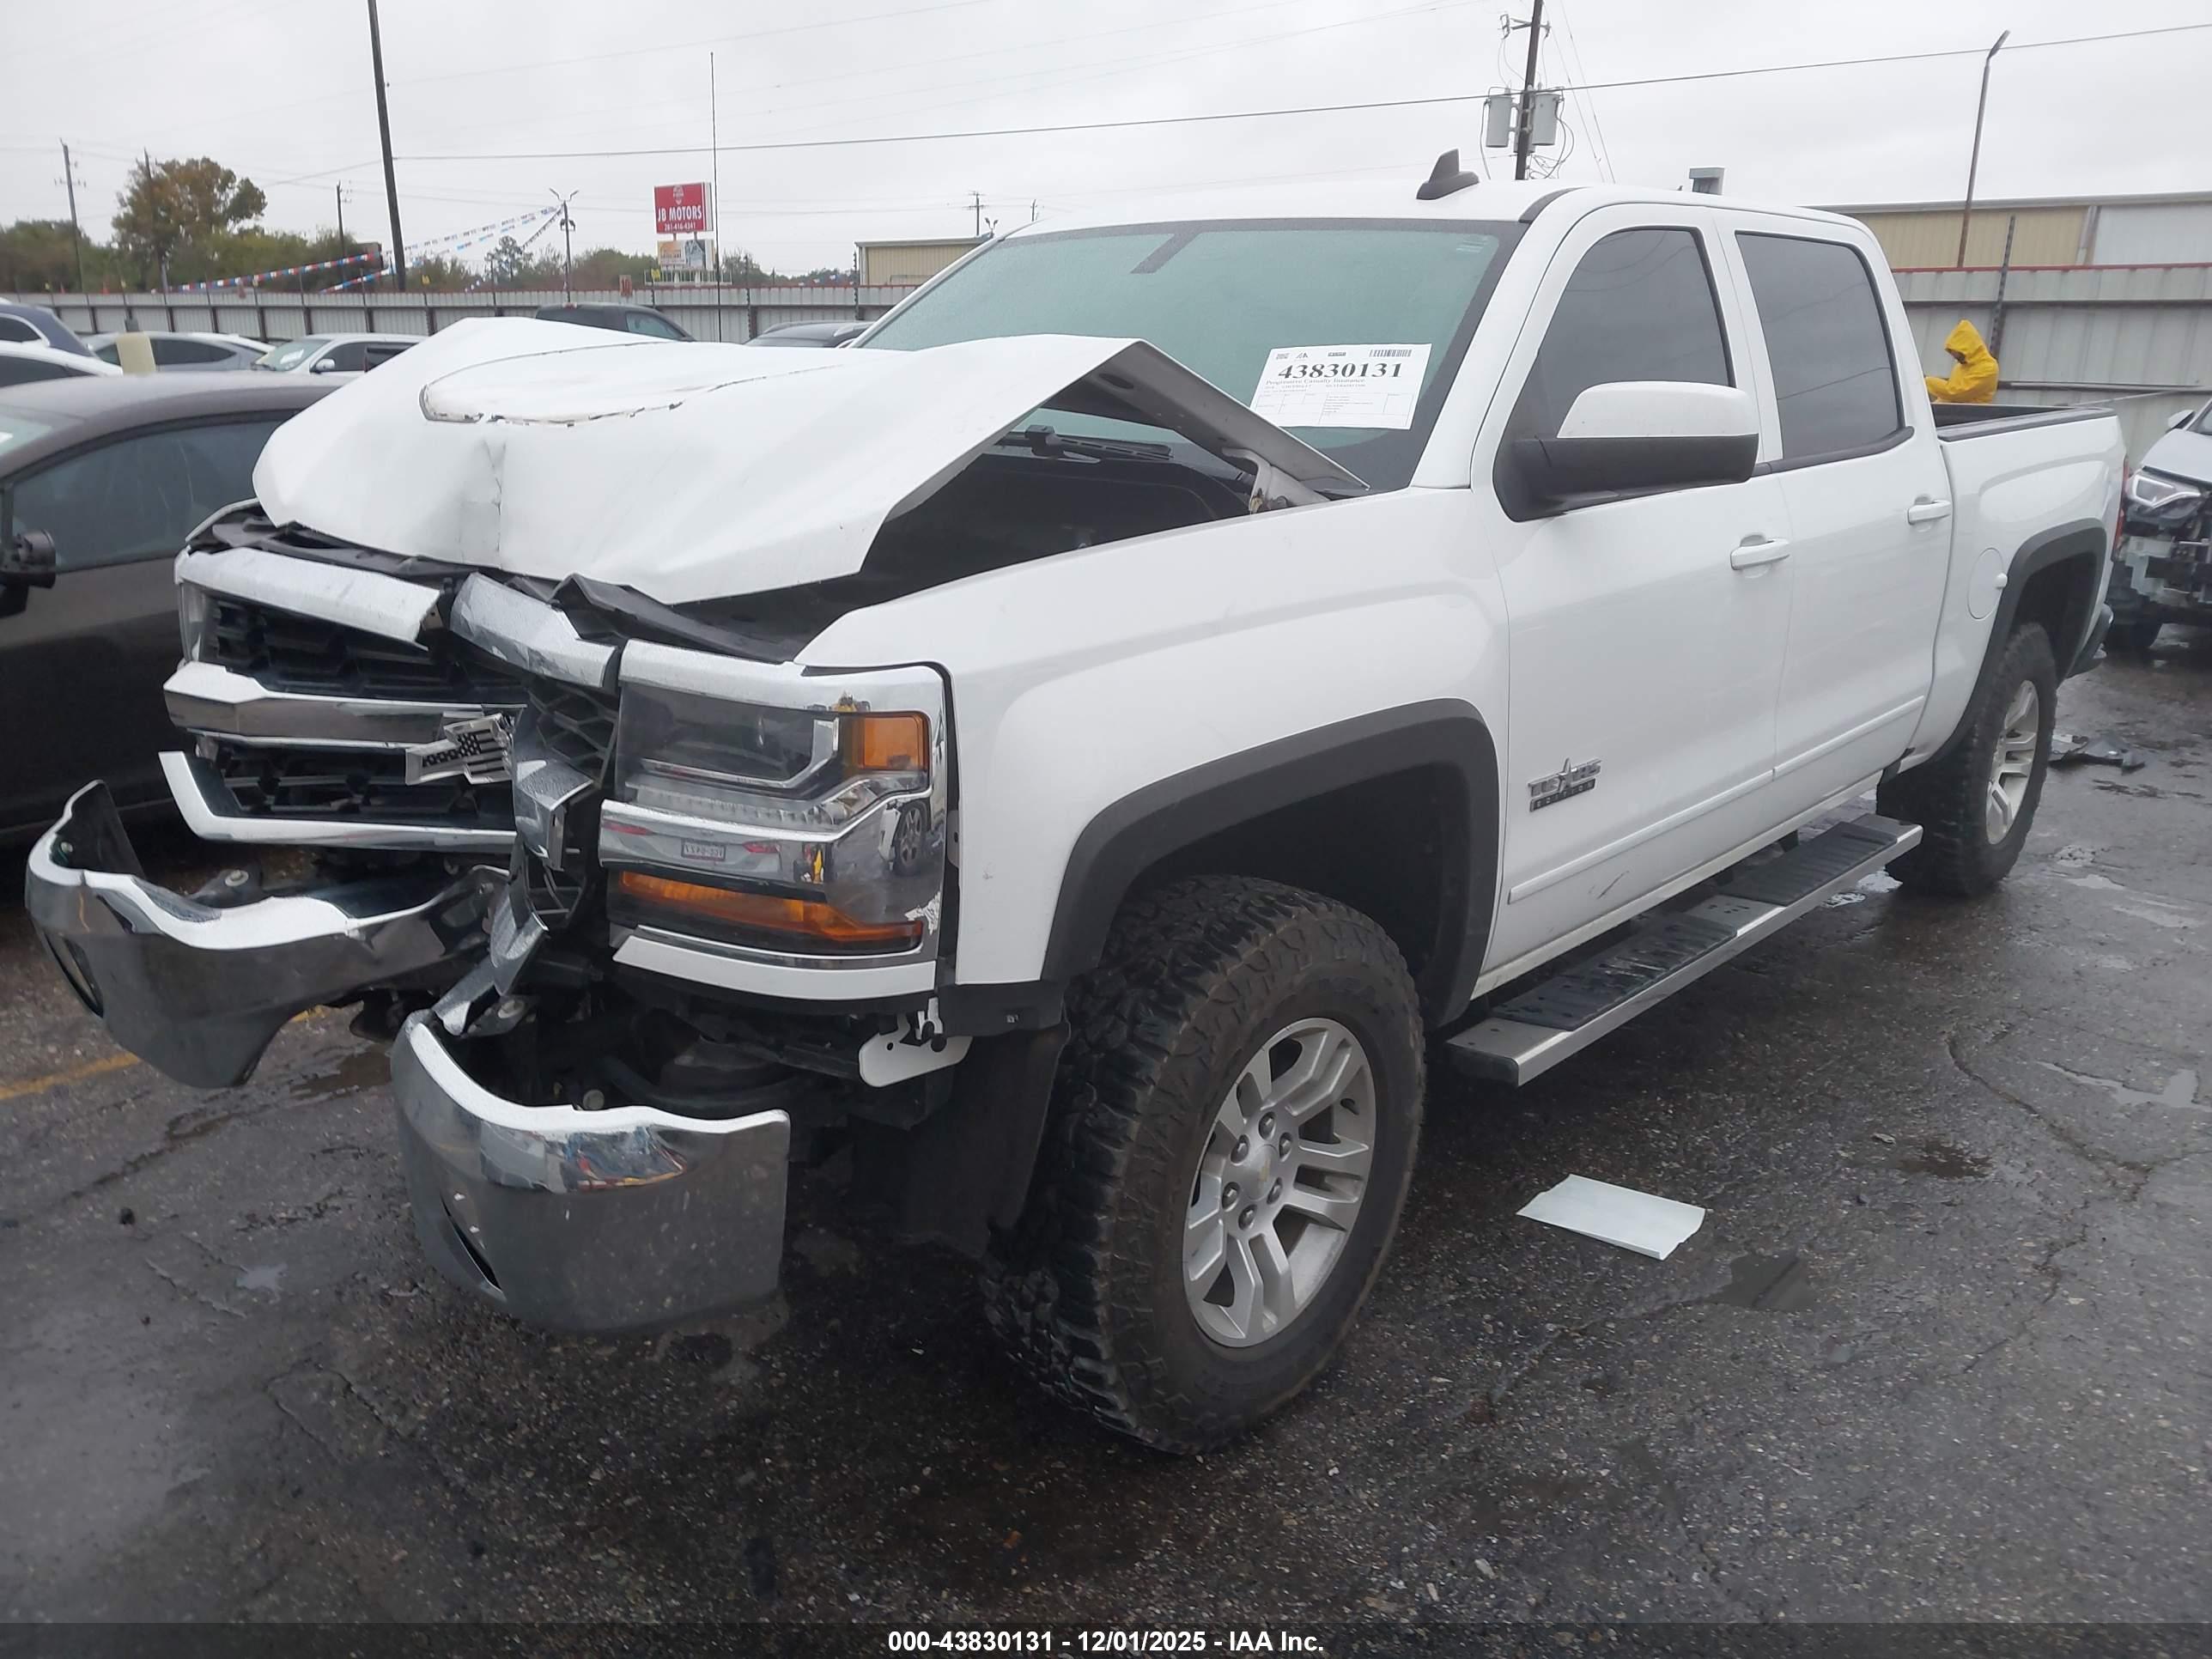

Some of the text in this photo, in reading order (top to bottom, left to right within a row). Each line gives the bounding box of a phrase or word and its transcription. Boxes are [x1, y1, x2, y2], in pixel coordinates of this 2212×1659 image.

[658, 205, 702, 222] JB MOTORS
[1278, 362, 1402, 379] 43830131
